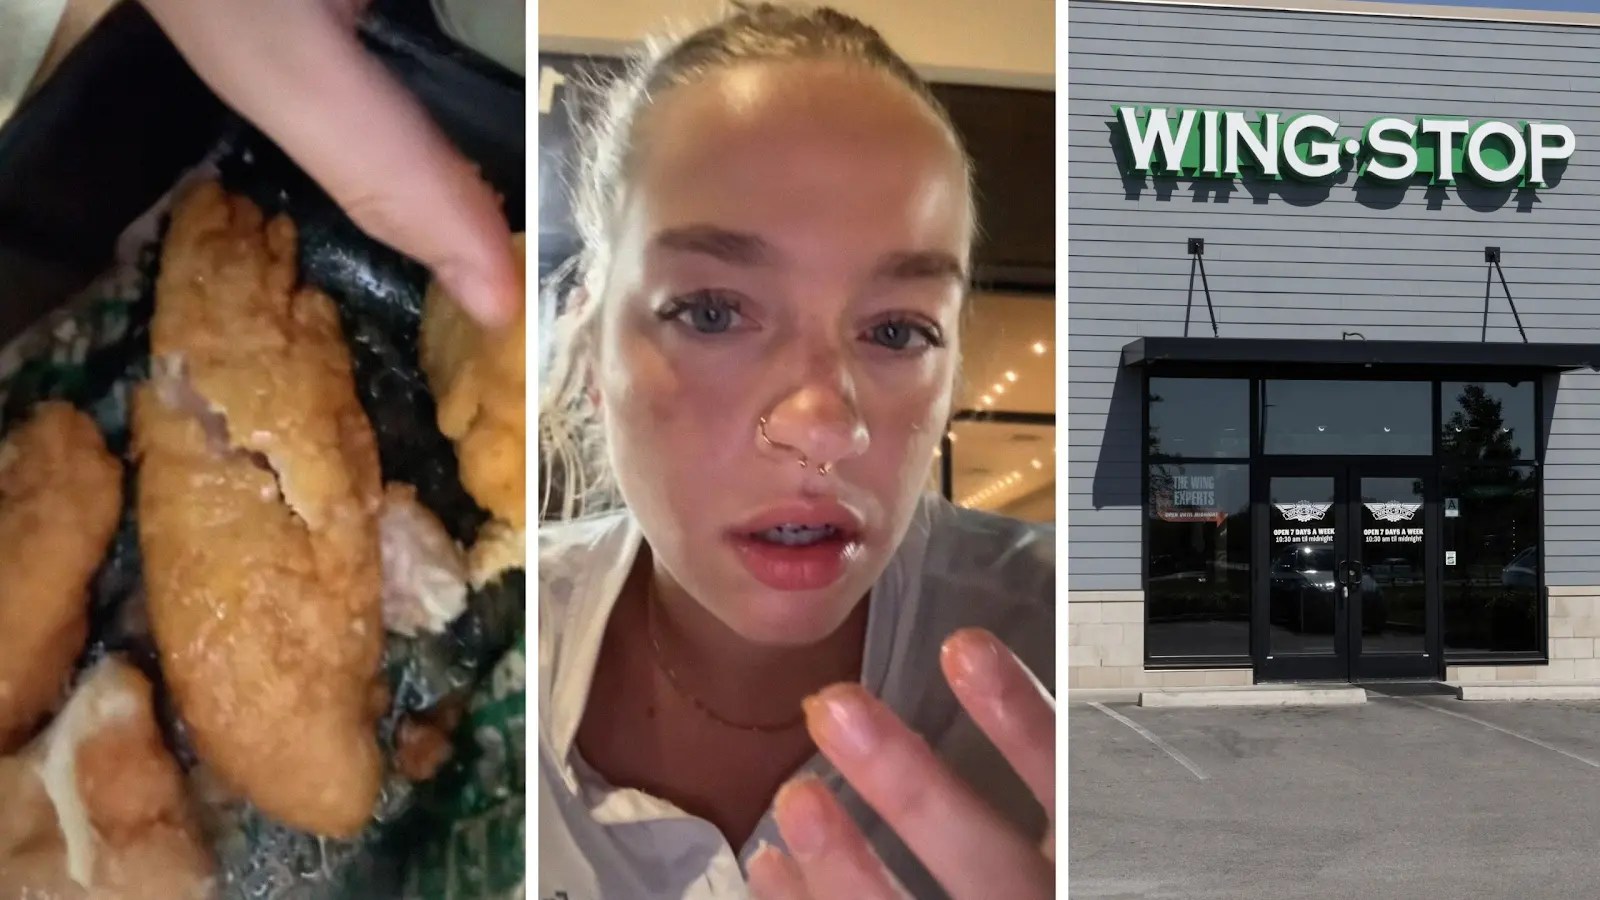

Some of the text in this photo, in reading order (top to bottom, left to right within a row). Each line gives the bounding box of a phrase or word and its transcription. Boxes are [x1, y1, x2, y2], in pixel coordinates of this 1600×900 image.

[1173, 476, 1215, 489] THE WING
[1174, 491, 1215, 506] EXPERTS
[1448, 500, 1456, 510] A
[1309, 536, 1333, 544] midnight
[1398, 536, 1422, 544] midnight
